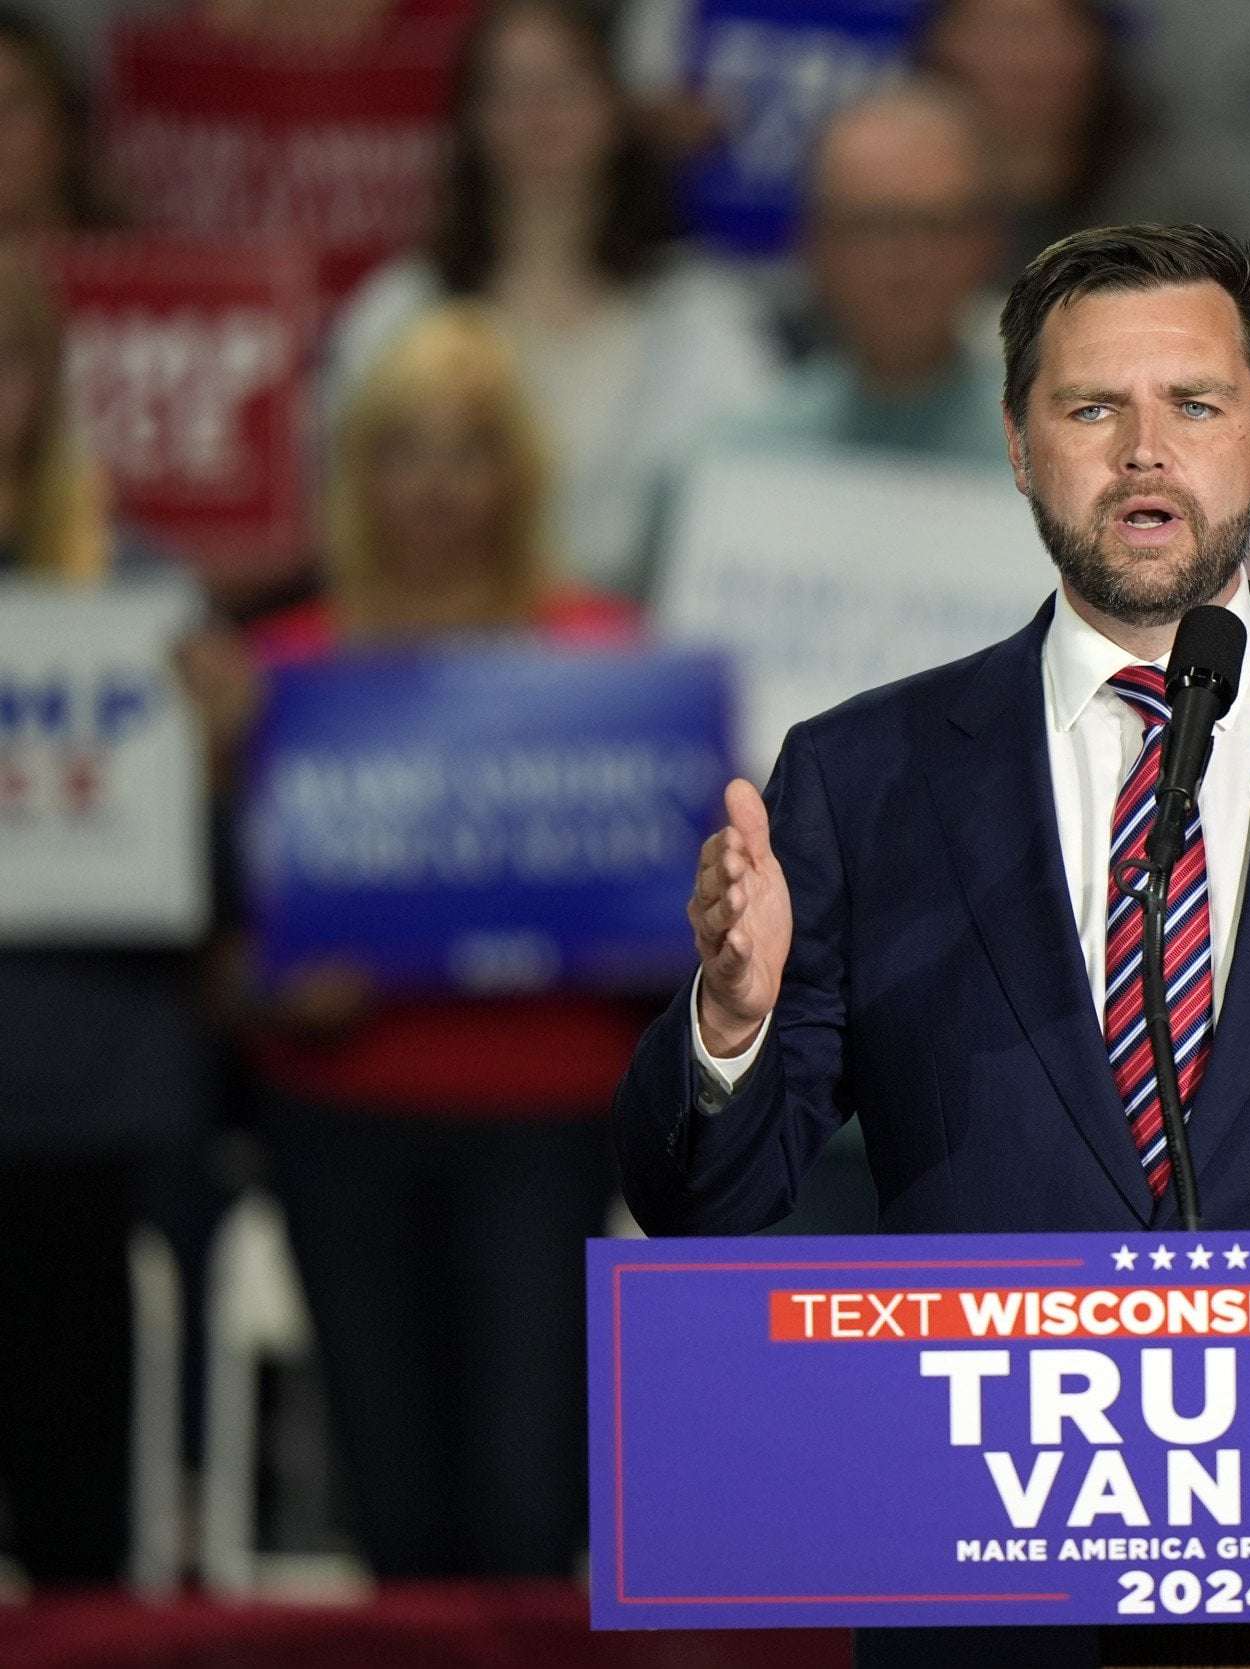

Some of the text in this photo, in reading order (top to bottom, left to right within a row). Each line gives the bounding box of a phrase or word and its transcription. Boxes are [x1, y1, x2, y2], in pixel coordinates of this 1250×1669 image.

[791, 1293, 942, 1338] TEXT
[955, 1538, 1049, 1563] MAKE
[1057, 1536, 1207, 1562] AMERICA
